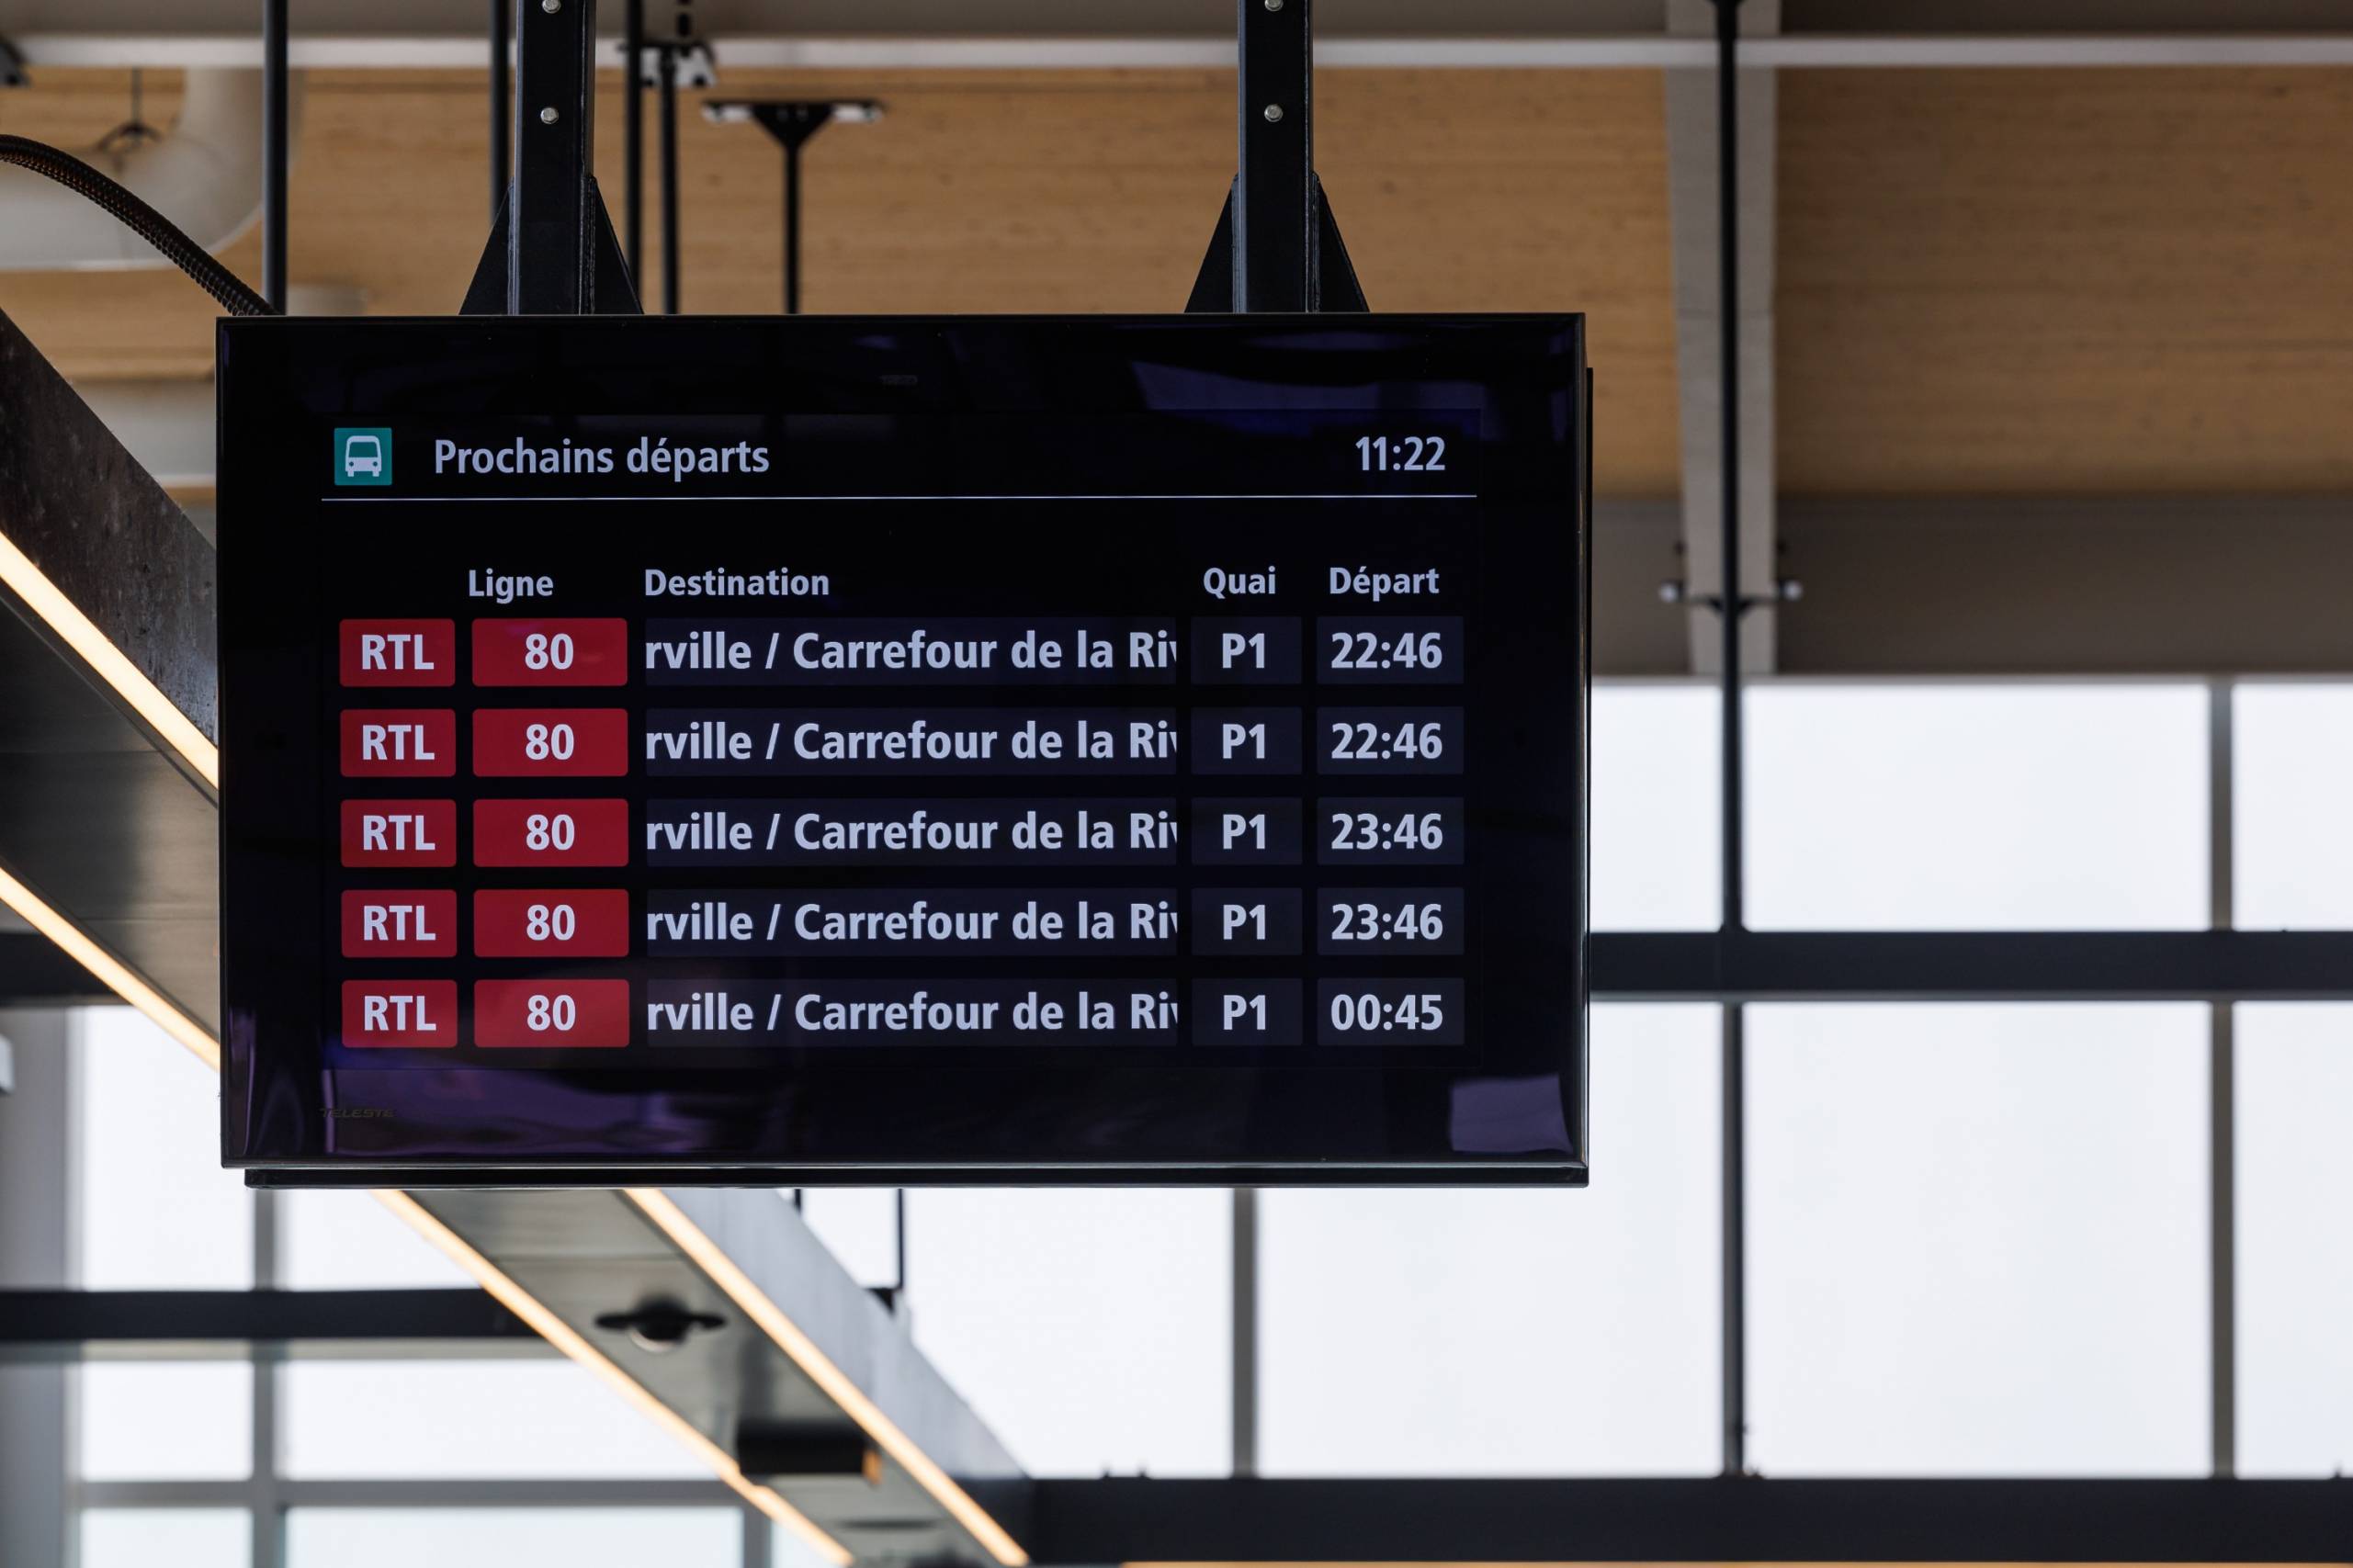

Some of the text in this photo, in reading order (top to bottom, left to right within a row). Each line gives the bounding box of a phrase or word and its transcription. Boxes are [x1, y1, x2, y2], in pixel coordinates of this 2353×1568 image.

[436, 436, 769, 482] Prochains départs
[1355, 435, 1446, 471] 11:22
[469, 568, 554, 604] Ligne
[645, 567, 829, 596] Destination
[1204, 565, 1276, 600] Quai
[1329, 566, 1440, 602] Départ
[361, 634, 435, 670] RTL
[525, 633, 574, 670] 80
[645, 630, 752, 670] rville
[764, 632, 780, 670] /
[793, 629, 998, 669] Carrefour
[1011, 629, 1062, 669] de
[1078, 629, 1113, 668] la
[1222, 633, 1266, 669] P1
[1330, 632, 1442, 669] 22:46
[361, 724, 436, 761] RTL
[526, 723, 574, 761] 80
[646, 721, 752, 760] rville
[765, 723, 780, 760] /
[794, 720, 998, 760] Carrefour
[1012, 720, 1063, 759] de
[1078, 720, 1114, 759] la
[1222, 723, 1266, 759] P1
[1331, 722, 1442, 760] 22:46
[362, 815, 436, 851] RTL
[526, 814, 575, 851] 80
[646, 811, 752, 851] rville
[765, 813, 781, 851] /
[794, 810, 998, 850] Carrefour
[1012, 810, 1063, 850] de
[1078, 810, 1114, 849] la
[1223, 814, 1266, 850] P1
[1331, 813, 1443, 850] 23:46
[363, 905, 436, 941] RTL
[526, 904, 575, 941] 80
[647, 902, 753, 941] rville
[766, 903, 781, 941] /
[795, 900, 999, 941] Carrefour
[1012, 901, 1063, 940] de
[1079, 901, 1114, 940] la
[1223, 904, 1266, 940] P1
[1331, 903, 1443, 941] 23:46
[364, 995, 437, 1032] RTL
[526, 994, 576, 1032] 80
[647, 992, 753, 1031] rville
[767, 994, 782, 1031] /
[795, 991, 999, 1031] Carrefour
[1012, 991, 1064, 1030] de
[1079, 991, 1114, 1030] la
[1223, 994, 1266, 1031] P1
[1330, 994, 1443, 1031] 00:45
[318, 1106, 396, 1119] TELESTE
